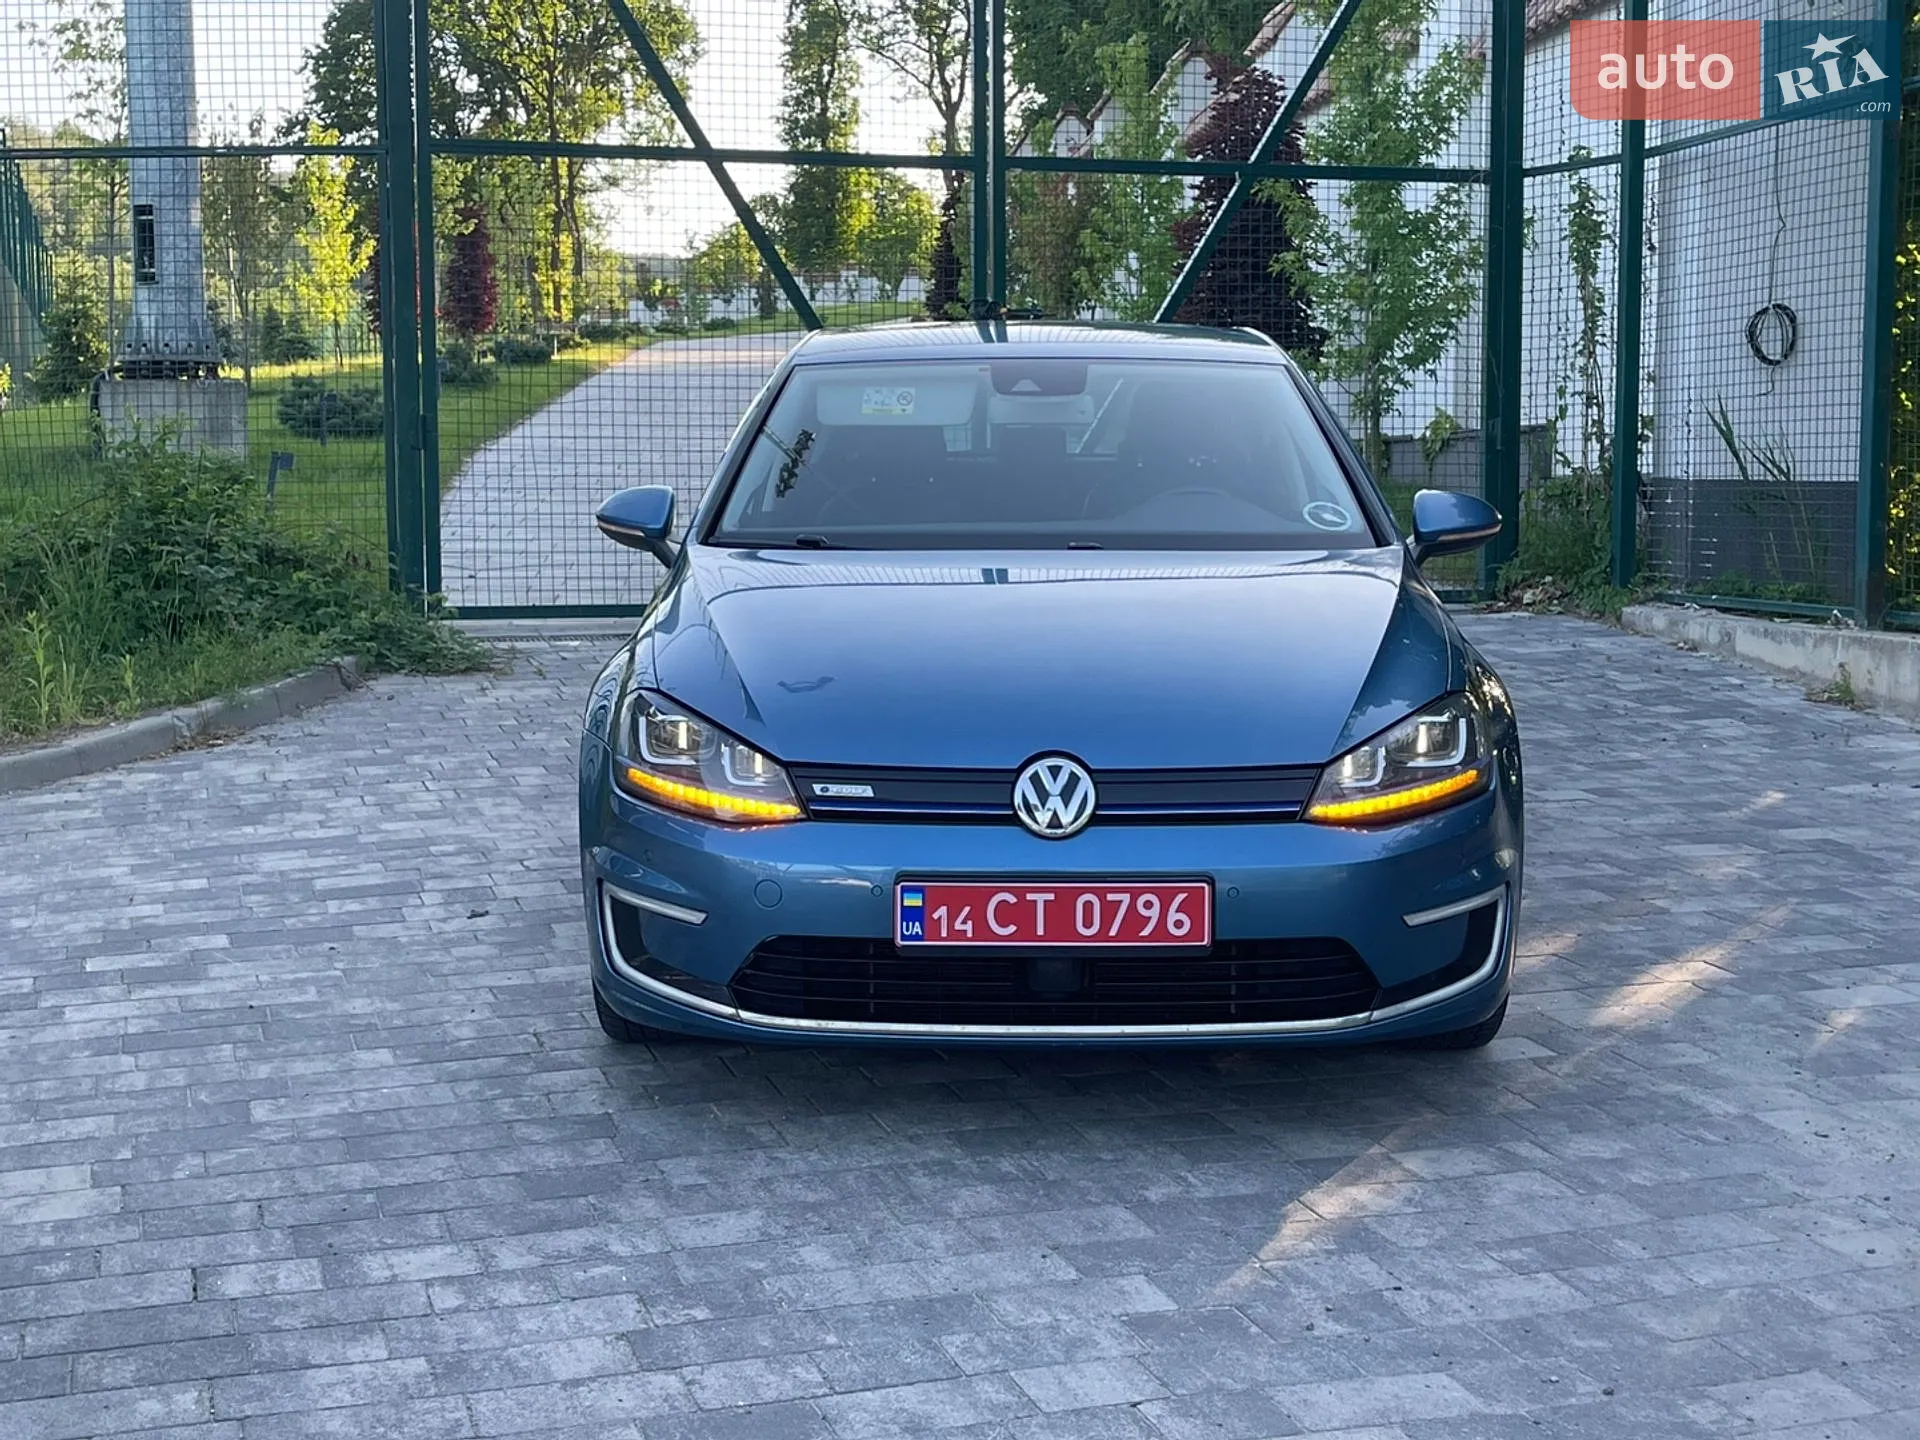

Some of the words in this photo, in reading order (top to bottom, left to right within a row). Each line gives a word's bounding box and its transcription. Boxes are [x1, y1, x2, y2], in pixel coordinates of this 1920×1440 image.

[902, 921, 922, 936] UA
[931, 905, 973, 938] 14
[986, 891, 1055, 936] CT
[1075, 892, 1192, 937] 0796
